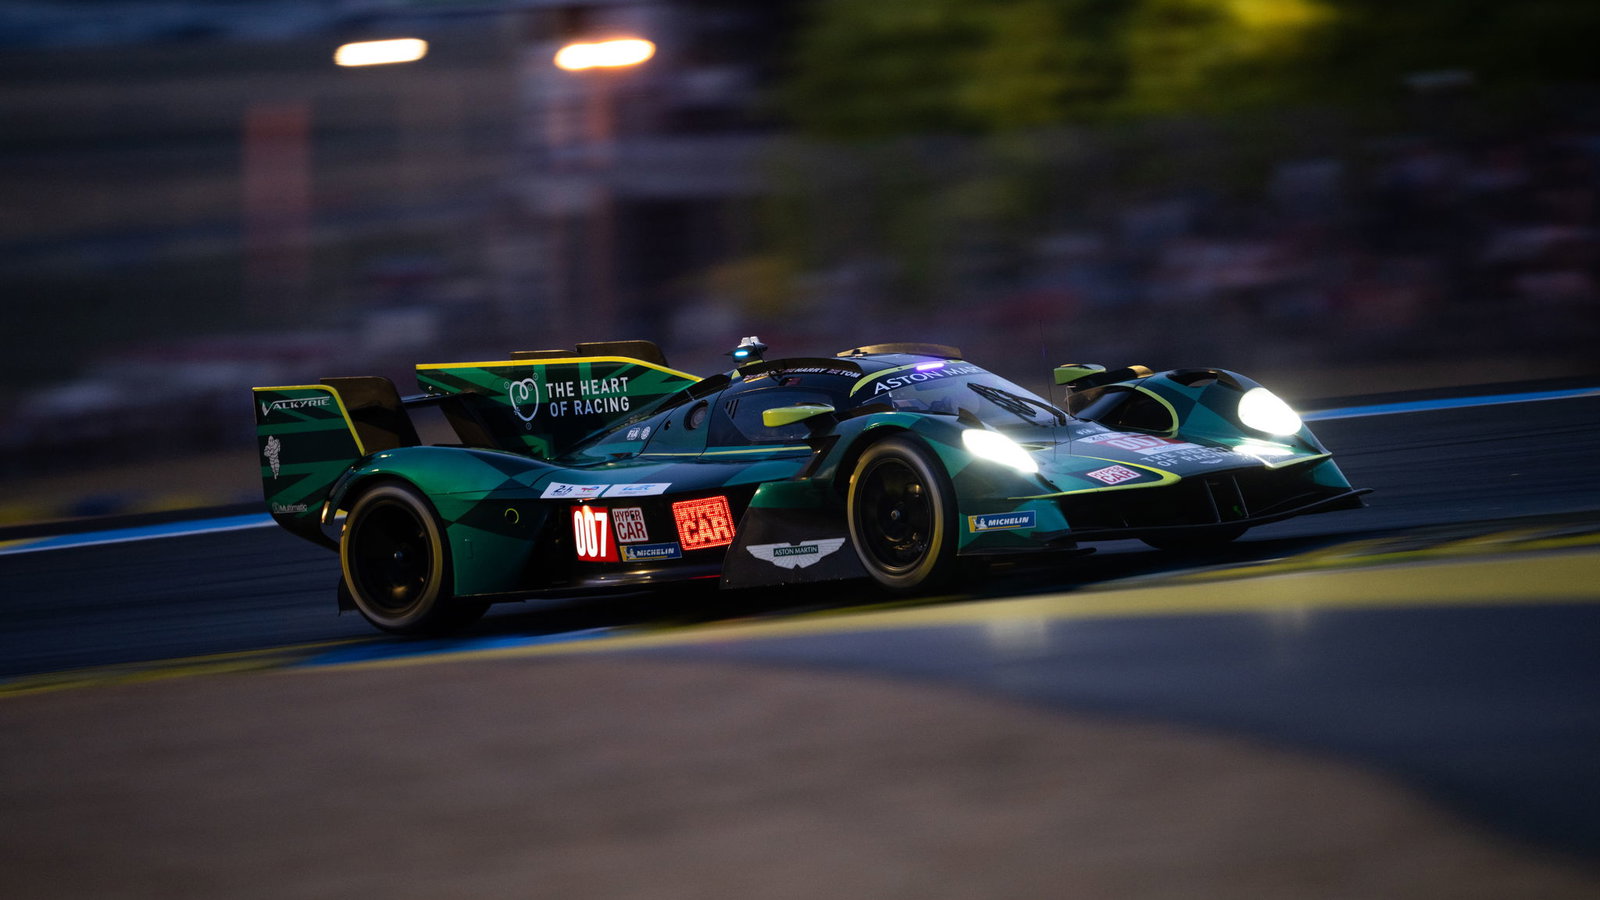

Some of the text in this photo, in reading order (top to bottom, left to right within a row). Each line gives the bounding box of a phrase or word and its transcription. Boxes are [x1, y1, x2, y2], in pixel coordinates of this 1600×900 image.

[839, 370, 862, 379] TOM
[874, 370, 944, 395] ASTON
[545, 376, 628, 399] THE HEART
[261, 395, 330, 416] VALKYRIE
[550, 396, 630, 417] OF RACING
[1140, 452, 1177, 462] THE
[1157, 459, 1178, 467] OF
[1101, 470, 1137, 483] CAR
[614, 510, 642, 522] HYPER
[677, 502, 725, 521] HYPER
[988, 516, 1029, 526] MICHELIN
[573, 509, 608, 558] 007
[616, 521, 647, 540] CAR
[682, 516, 732, 544] CAR
[636, 547, 676, 557] MICHELIN
[774, 545, 818, 557] ASTON MARTIN
